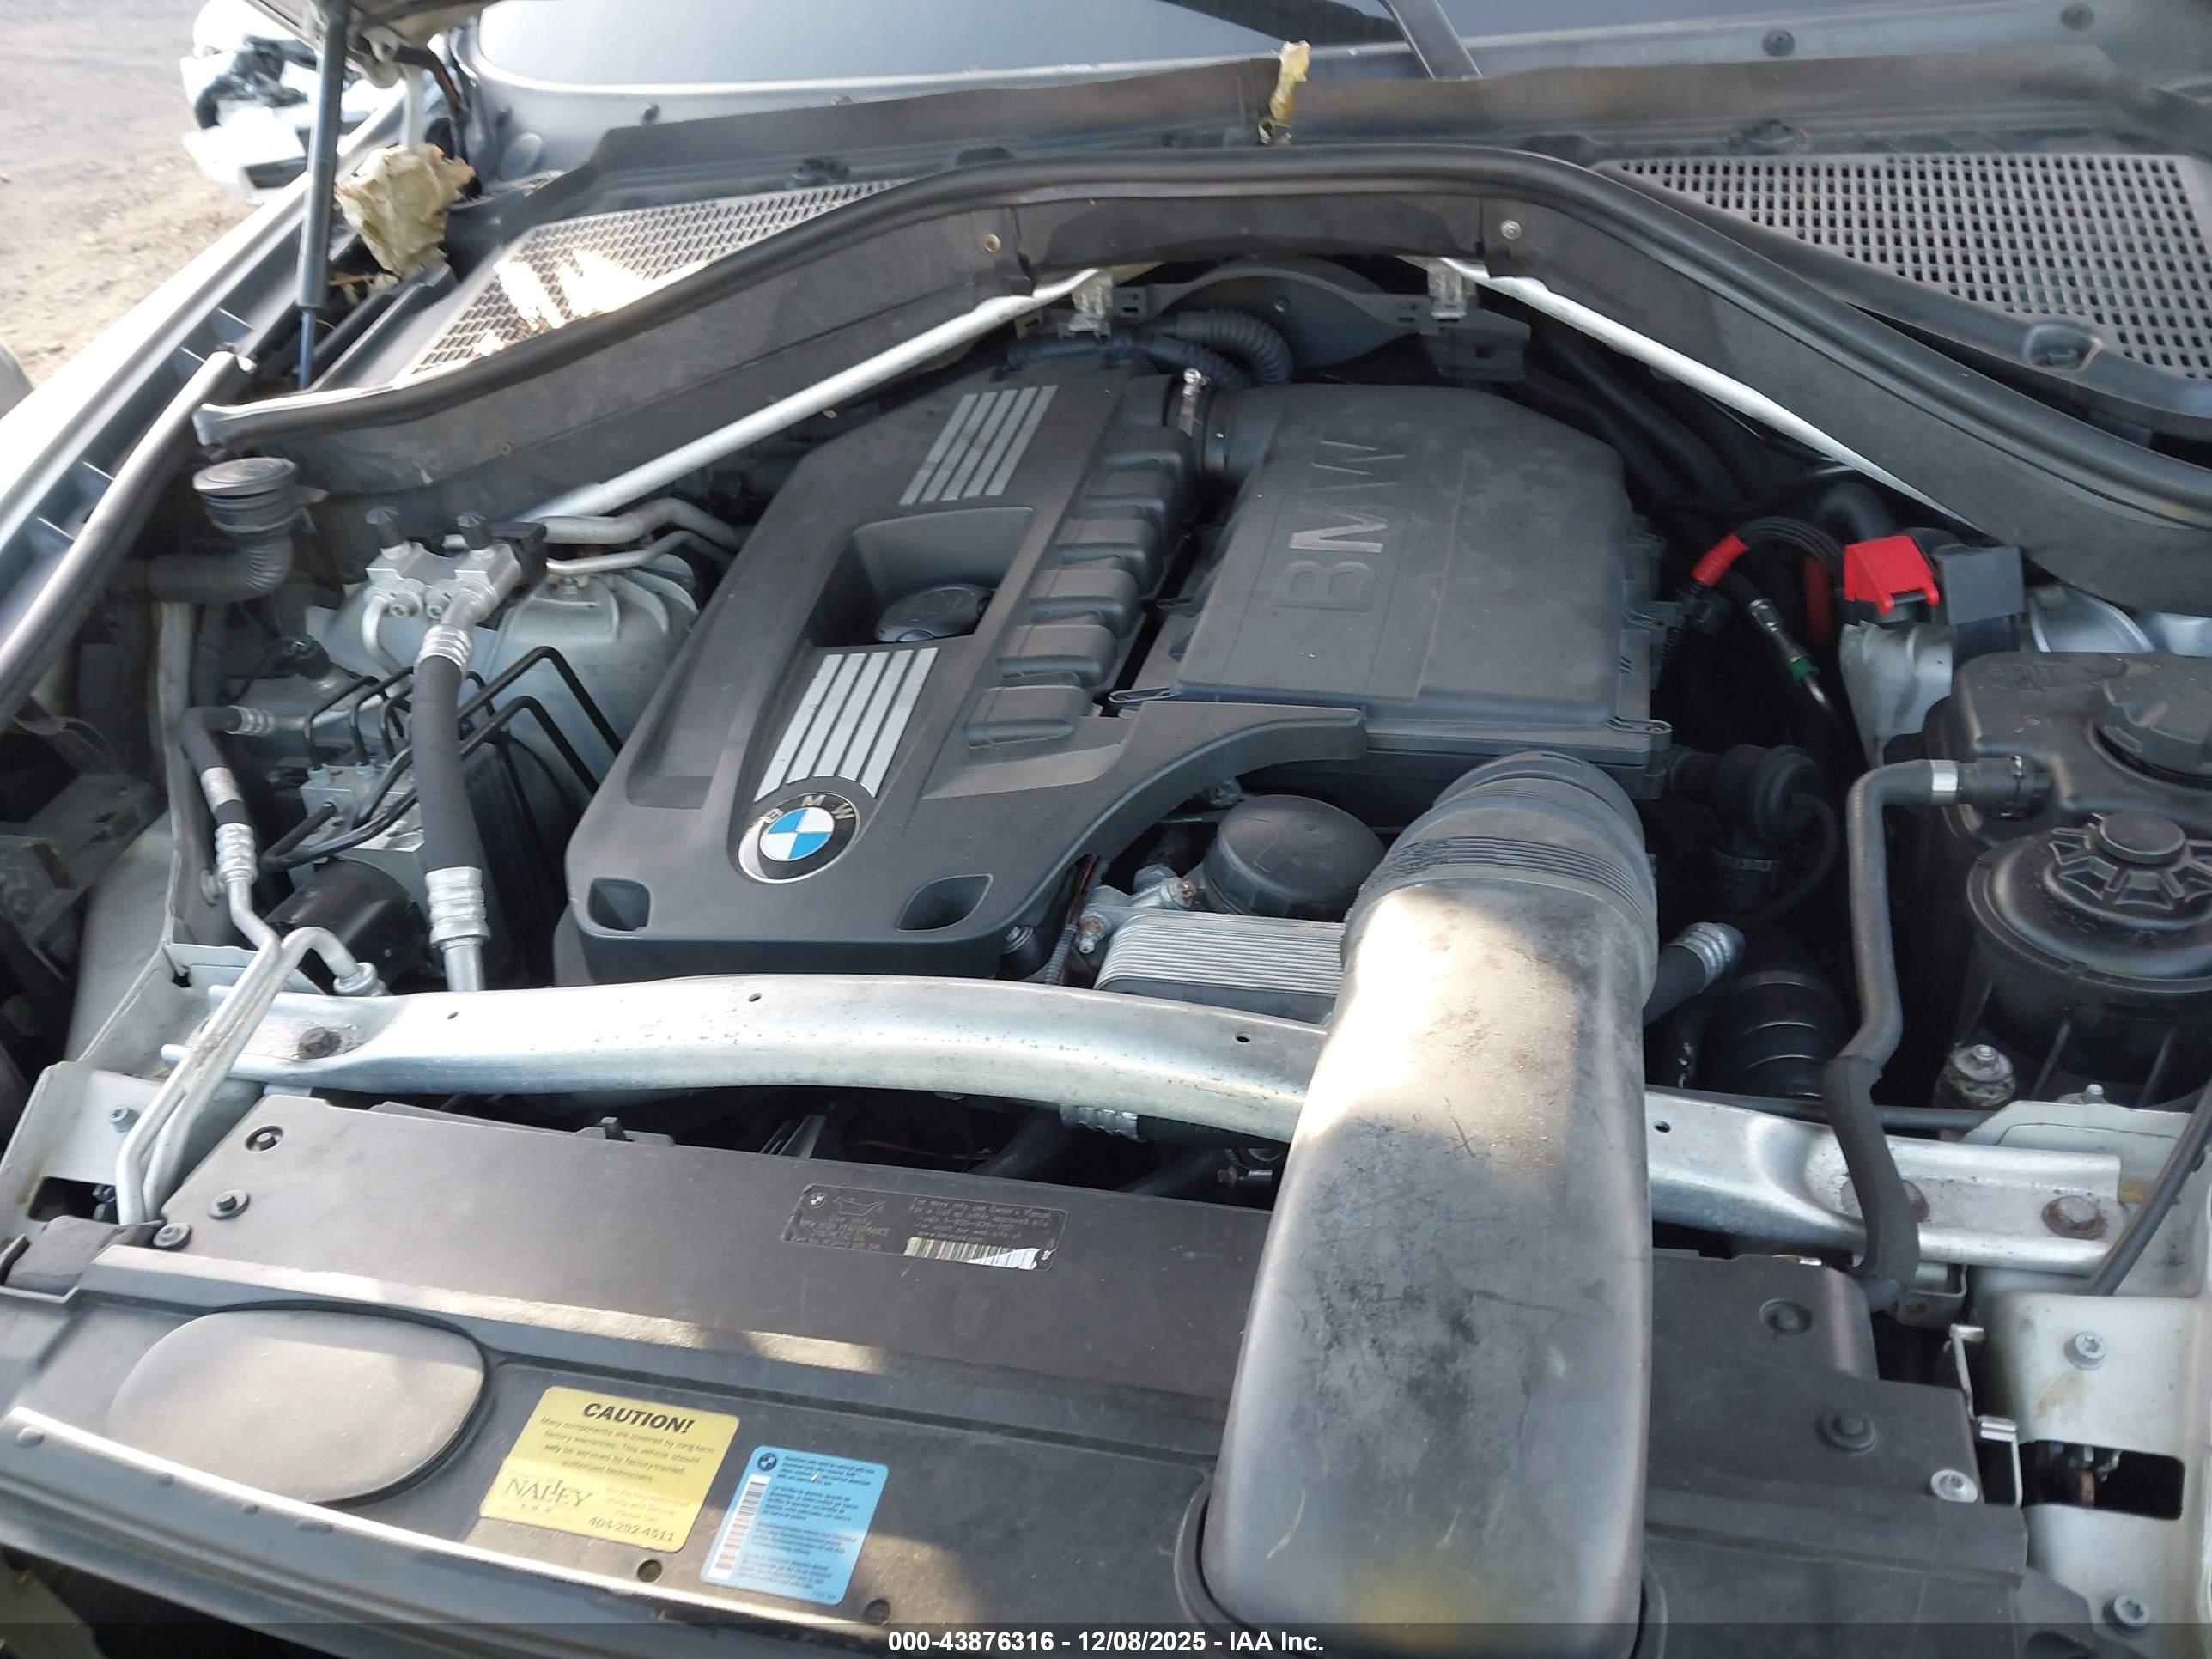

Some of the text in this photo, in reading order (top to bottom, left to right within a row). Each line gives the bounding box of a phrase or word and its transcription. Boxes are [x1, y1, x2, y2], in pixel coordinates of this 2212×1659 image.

[1271, 440, 1406, 613] BMW
[760, 794, 855, 823] BMW
[538, 1416, 565, 1428] Many
[561, 1421, 614, 1437] components
[629, 1433, 664, 1444] covered
[663, 1438, 675, 1448] by
[582, 1402, 695, 1434] CAUTION!
[541, 1443, 563, 1454] only
[574, 1449, 611, 1462] serviced
[611, 1455, 623, 1464] by
[542, 1430, 574, 1443] factory
[621, 1443, 639, 1453] This
[640, 1448, 670, 1458] vehicle
[670, 1453, 701, 1464] should
[560, 1459, 605, 1473] authorized
